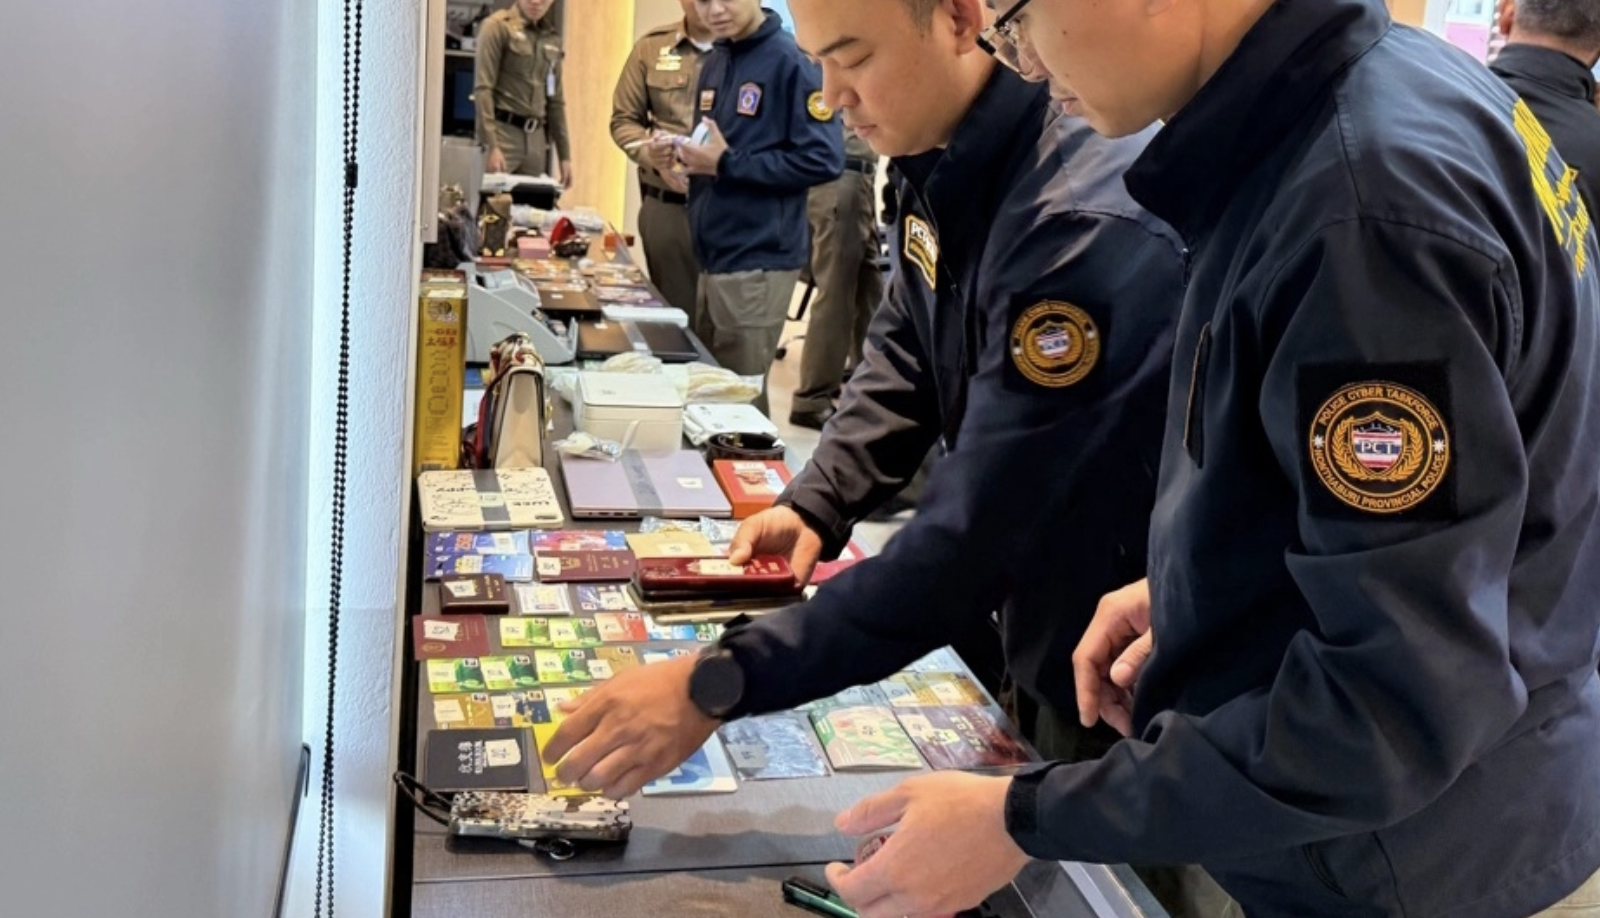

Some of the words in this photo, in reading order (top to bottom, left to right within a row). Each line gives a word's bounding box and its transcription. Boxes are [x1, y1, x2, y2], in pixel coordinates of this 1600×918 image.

[1318, 396, 1348, 426] POLICE
[1347, 387, 1384, 402] CYBER
[1385, 387, 1440, 430] TASKFORCE
[1359, 440, 1396, 454] PCT
[1314, 449, 1362, 504] NONTHABURI
[1361, 488, 1426, 510] PROVINCIAL
[1420, 454, 1446, 490] POLICE
